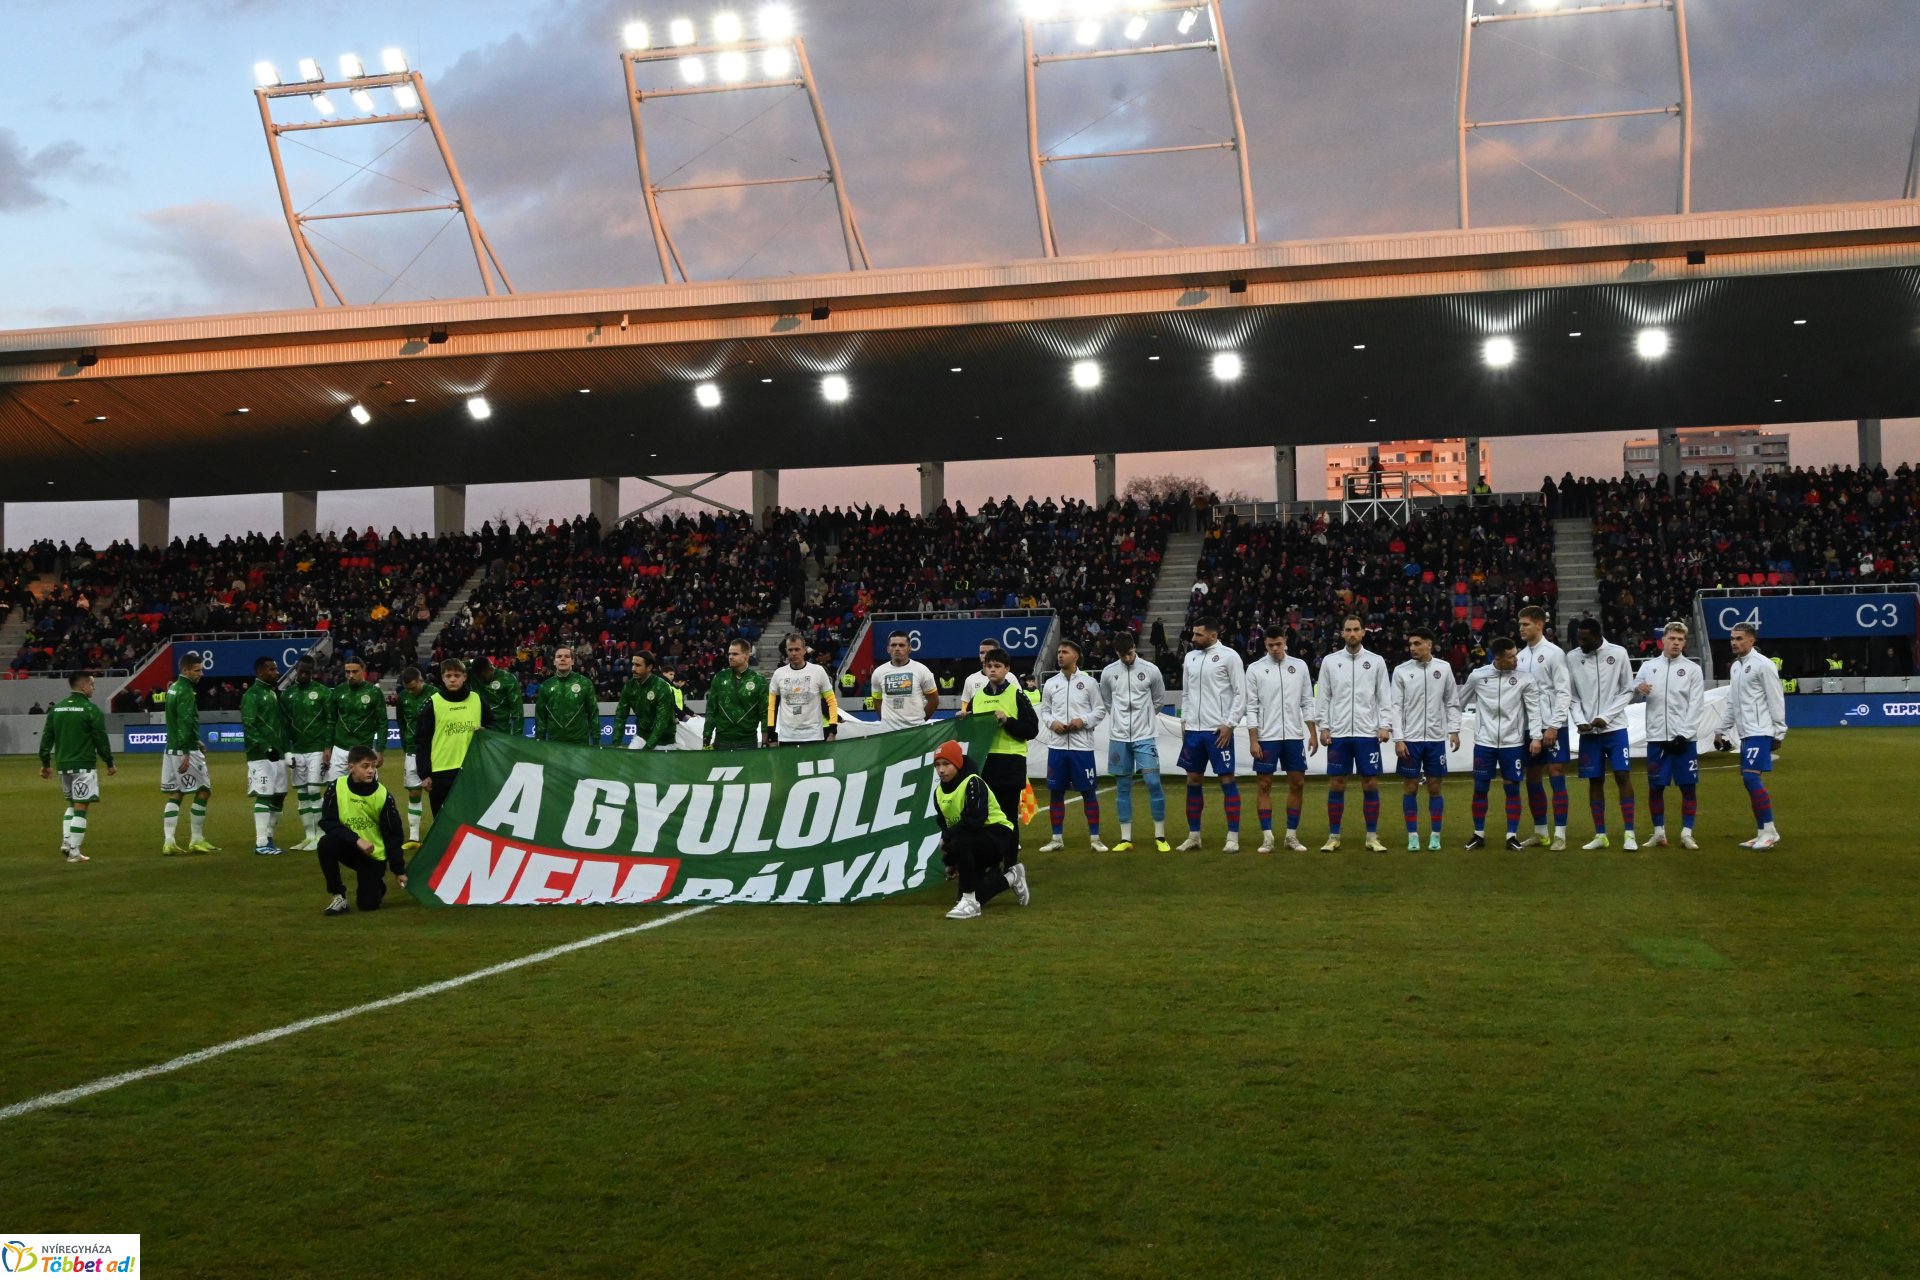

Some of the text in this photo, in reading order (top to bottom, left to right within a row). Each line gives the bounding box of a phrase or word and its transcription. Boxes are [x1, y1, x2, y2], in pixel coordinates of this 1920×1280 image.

[1718, 606, 1762, 632] C4
[1856, 603, 1898, 628] C3
[1002, 626, 1039, 650] C5
[1785, 684, 1793, 692] 15
[1220, 750, 1231, 762] 13
[1369, 752, 1380, 764] 27
[1622, 747, 1629, 759] 8
[1746, 747, 1760, 759] 77
[1515, 758, 1522, 770] 6
[1084, 768, 1095, 779] 14
[476, 761, 545, 841] A
[434, 831, 670, 906] NEM
